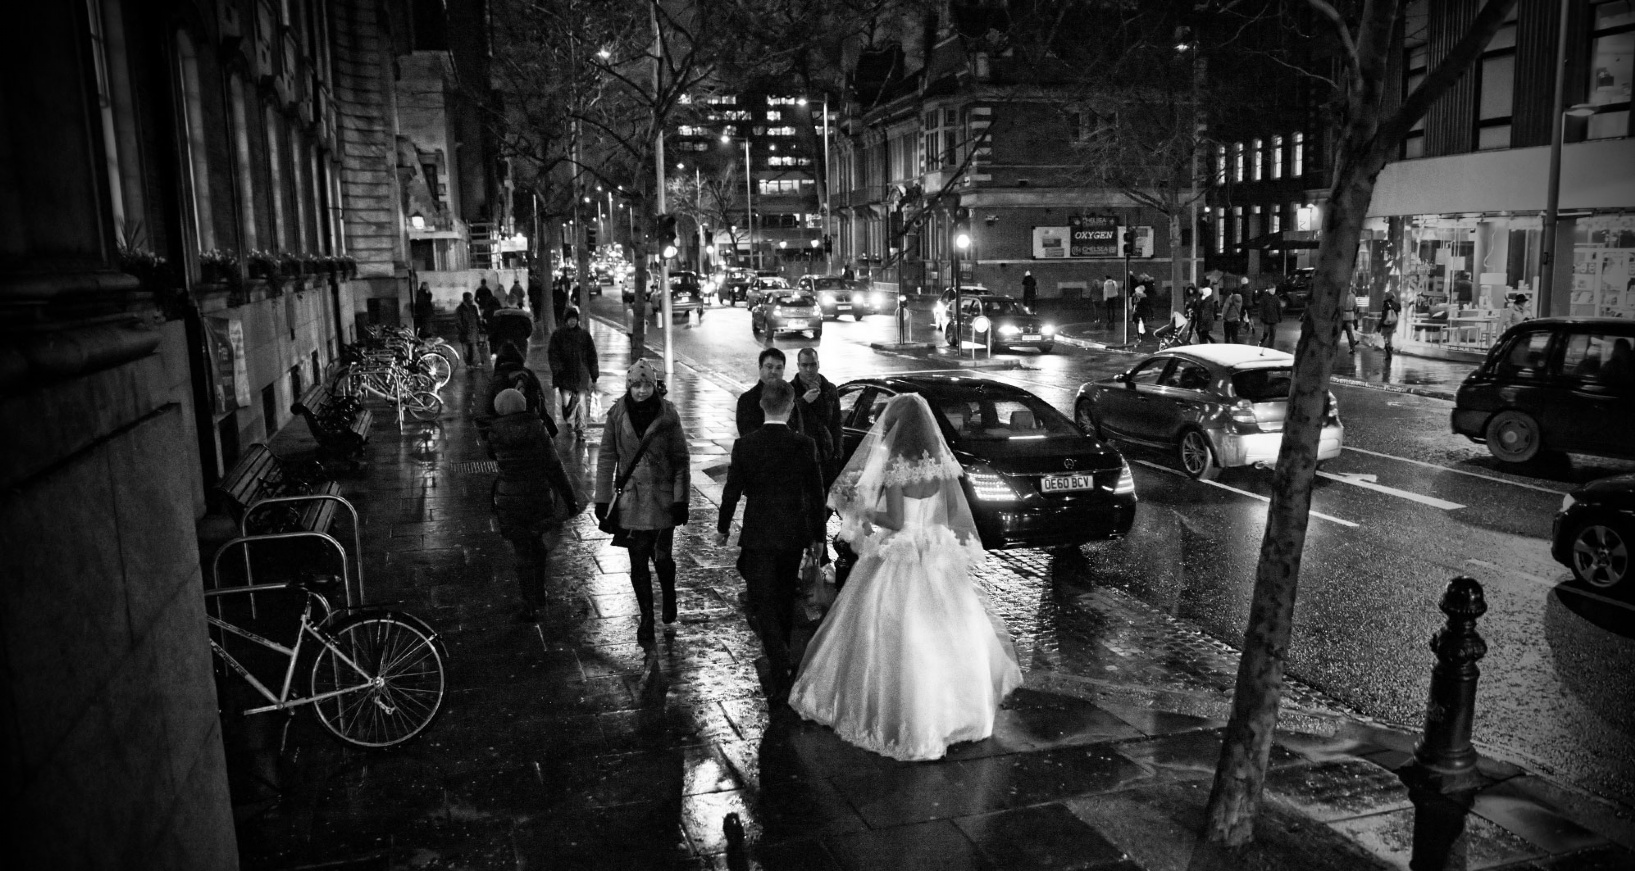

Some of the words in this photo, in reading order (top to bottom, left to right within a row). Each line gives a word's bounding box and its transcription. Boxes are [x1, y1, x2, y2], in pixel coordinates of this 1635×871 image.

[1075, 231, 1114, 240] OXYGEN
[1409, 275, 1444, 297] SALE
[1045, 478, 1069, 490] OE60
[1071, 476, 1089, 489] BCV
